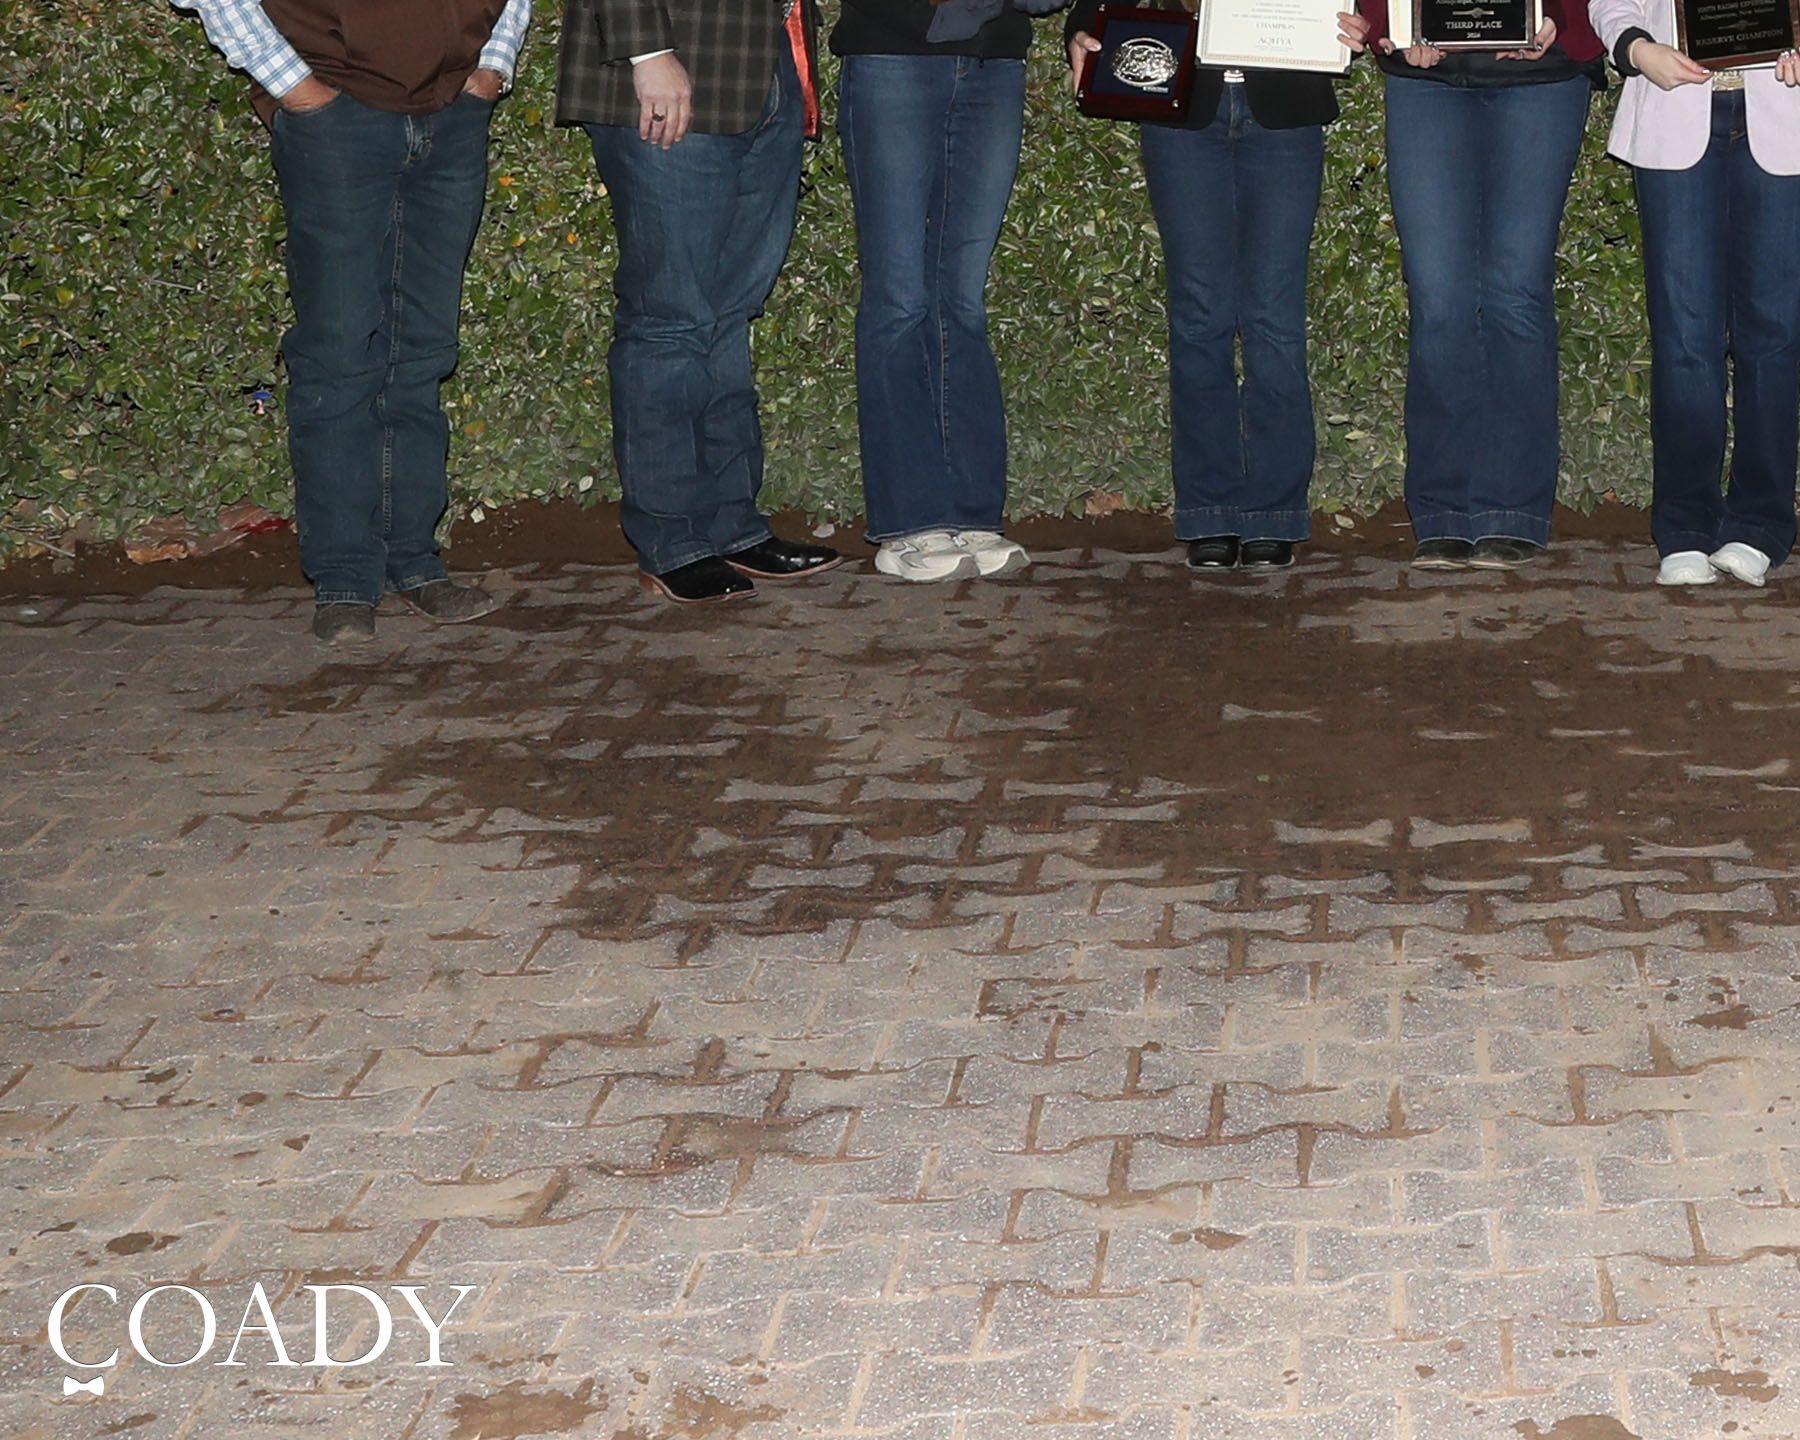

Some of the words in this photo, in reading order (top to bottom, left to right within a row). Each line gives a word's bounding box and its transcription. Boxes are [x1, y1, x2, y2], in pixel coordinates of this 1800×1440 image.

[1256, 23, 1296, 31] CHAMPION
[1445, 21, 1473, 29] THIRD
[1474, 21, 1503, 29] PLACE
[1257, 36, 1293, 47] AQHYA
[1696, 35, 1735, 47] RESERVE
[1736, 29, 1784, 42] CHAMPION
